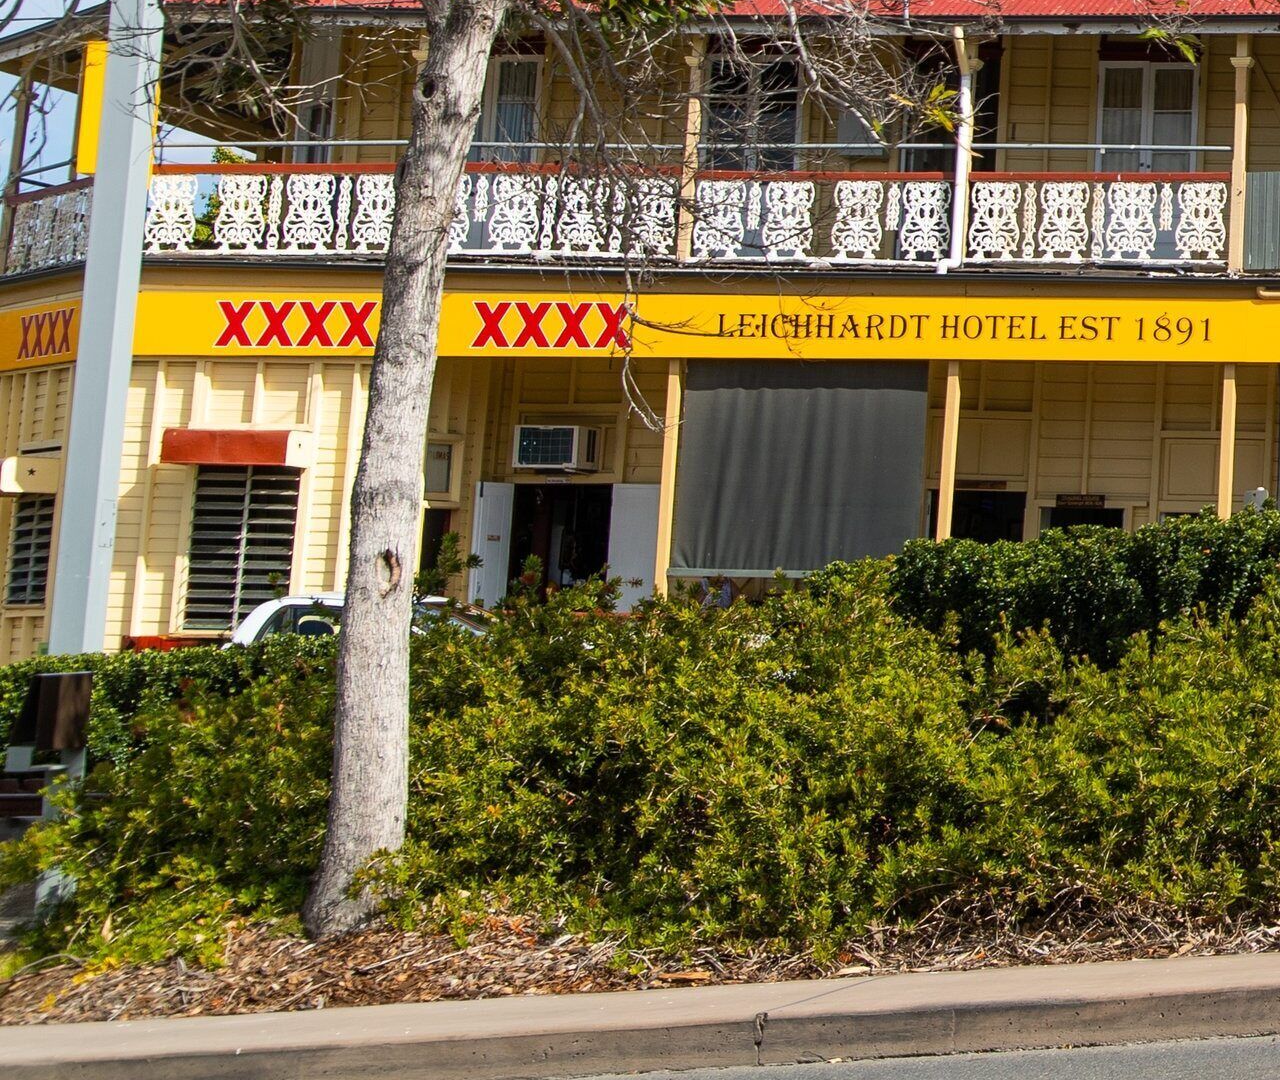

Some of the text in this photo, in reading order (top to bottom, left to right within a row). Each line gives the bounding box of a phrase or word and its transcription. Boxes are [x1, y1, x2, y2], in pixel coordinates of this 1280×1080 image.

[16, 307, 77, 361] XXXX
[213, 300, 380, 348] XXXX
[470, 301, 636, 349] XXXX
[717, 313, 1212, 344] LEICHHARDT HOTEL EST 1891
